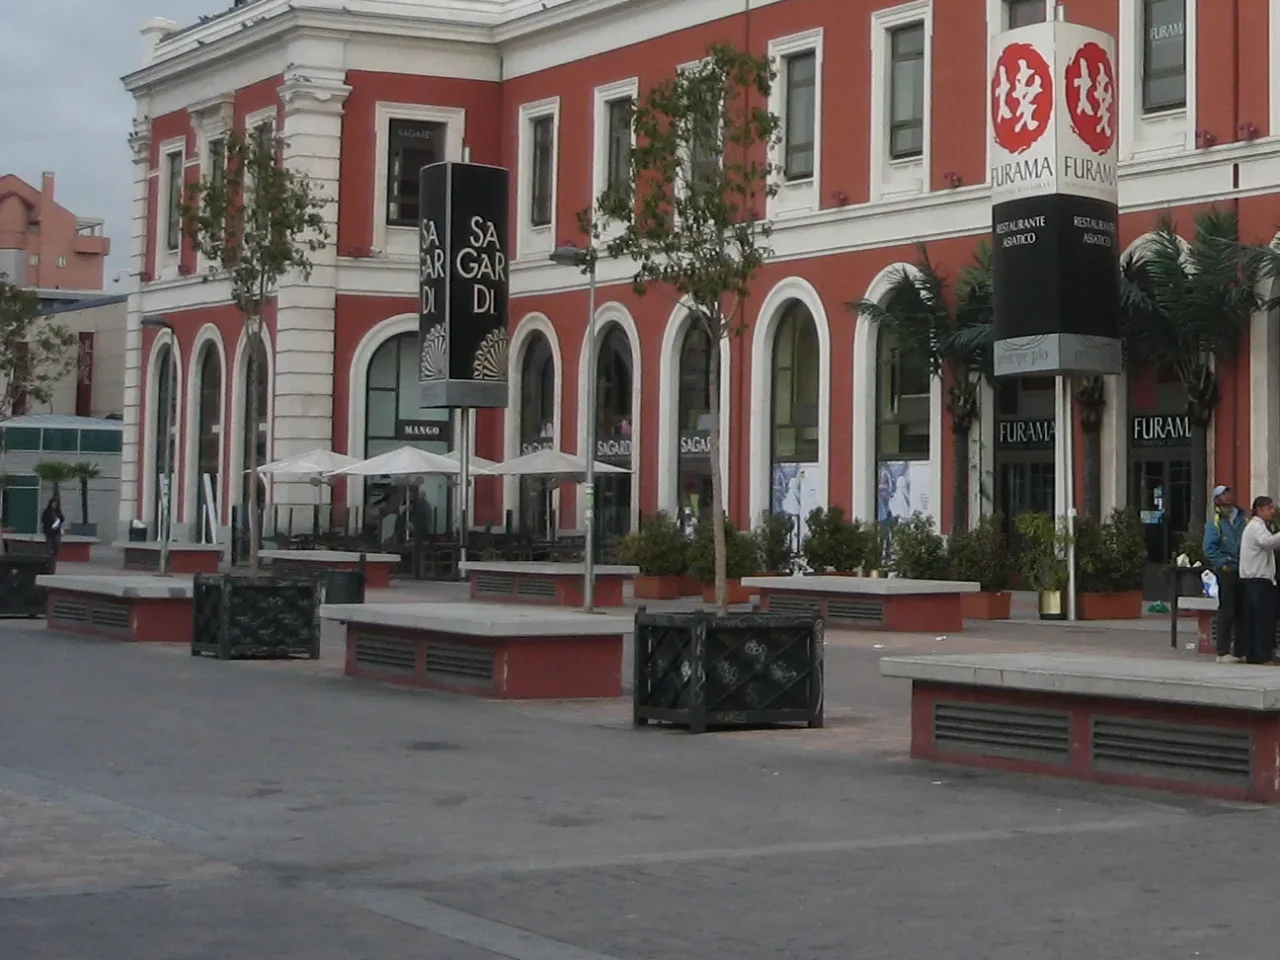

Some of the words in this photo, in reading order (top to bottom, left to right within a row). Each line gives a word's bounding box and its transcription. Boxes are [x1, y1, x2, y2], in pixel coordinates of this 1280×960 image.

[991, 156, 1053, 188] FURAMA
[422, 218, 440, 249] SA
[469, 215, 500, 249] SA
[996, 215, 1046, 234] RESTAURANTE
[1002, 232, 1036, 248] ASIATICO
[456, 247, 506, 281] GAR
[423, 285, 436, 314] DI
[473, 283, 496, 314] DI
[404, 425, 440, 435] MANGO
[1134, 415, 1192, 439] FURAM
